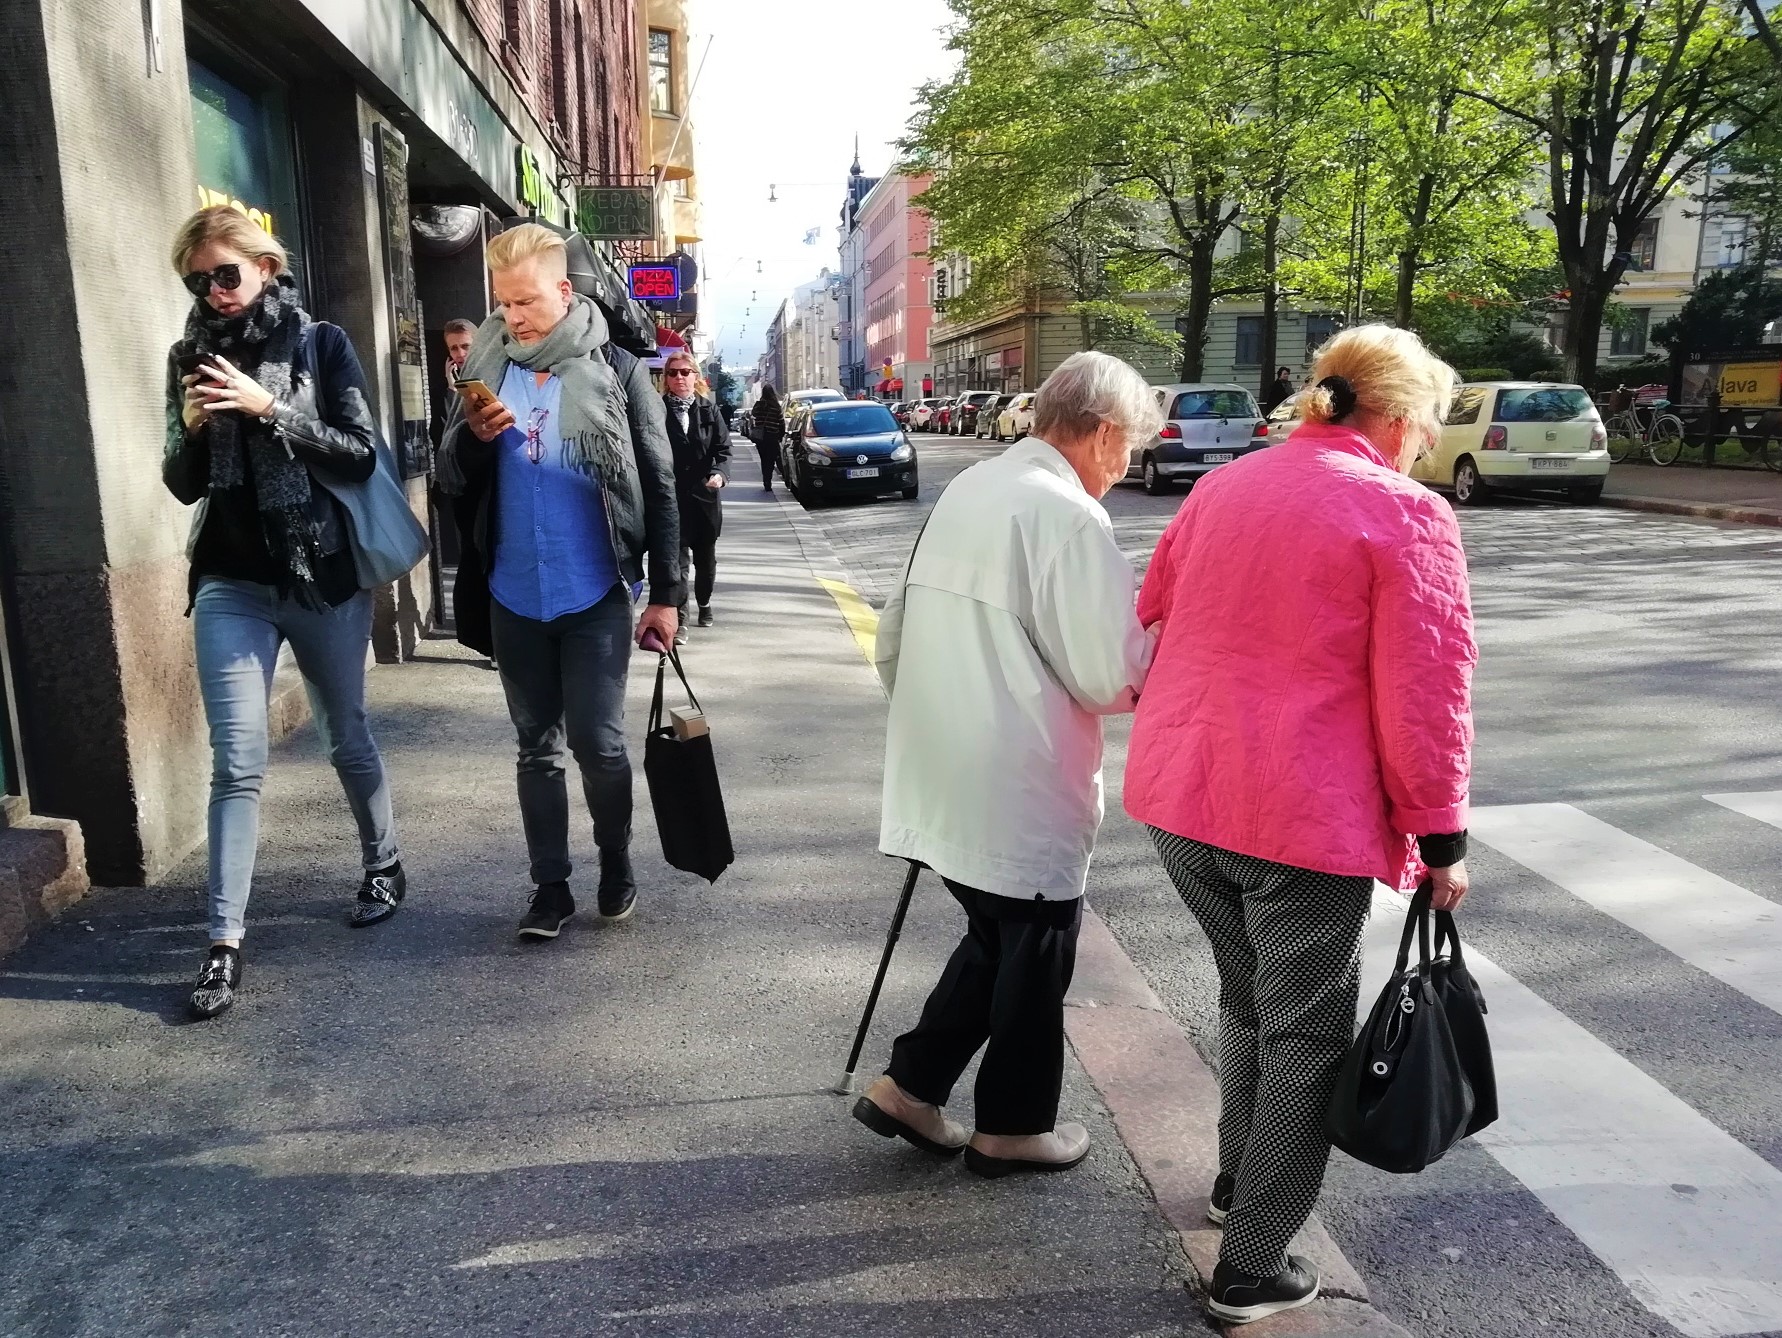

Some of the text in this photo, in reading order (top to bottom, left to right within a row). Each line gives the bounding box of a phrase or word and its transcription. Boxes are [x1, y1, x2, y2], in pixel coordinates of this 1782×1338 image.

[585, 193, 648, 209] KEBAB
[587, 215, 645, 231] OPEN
[633, 270, 673, 281] PIZZA
[635, 283, 675, 296] OPEN
[1690, 352, 1700, 360] 30
